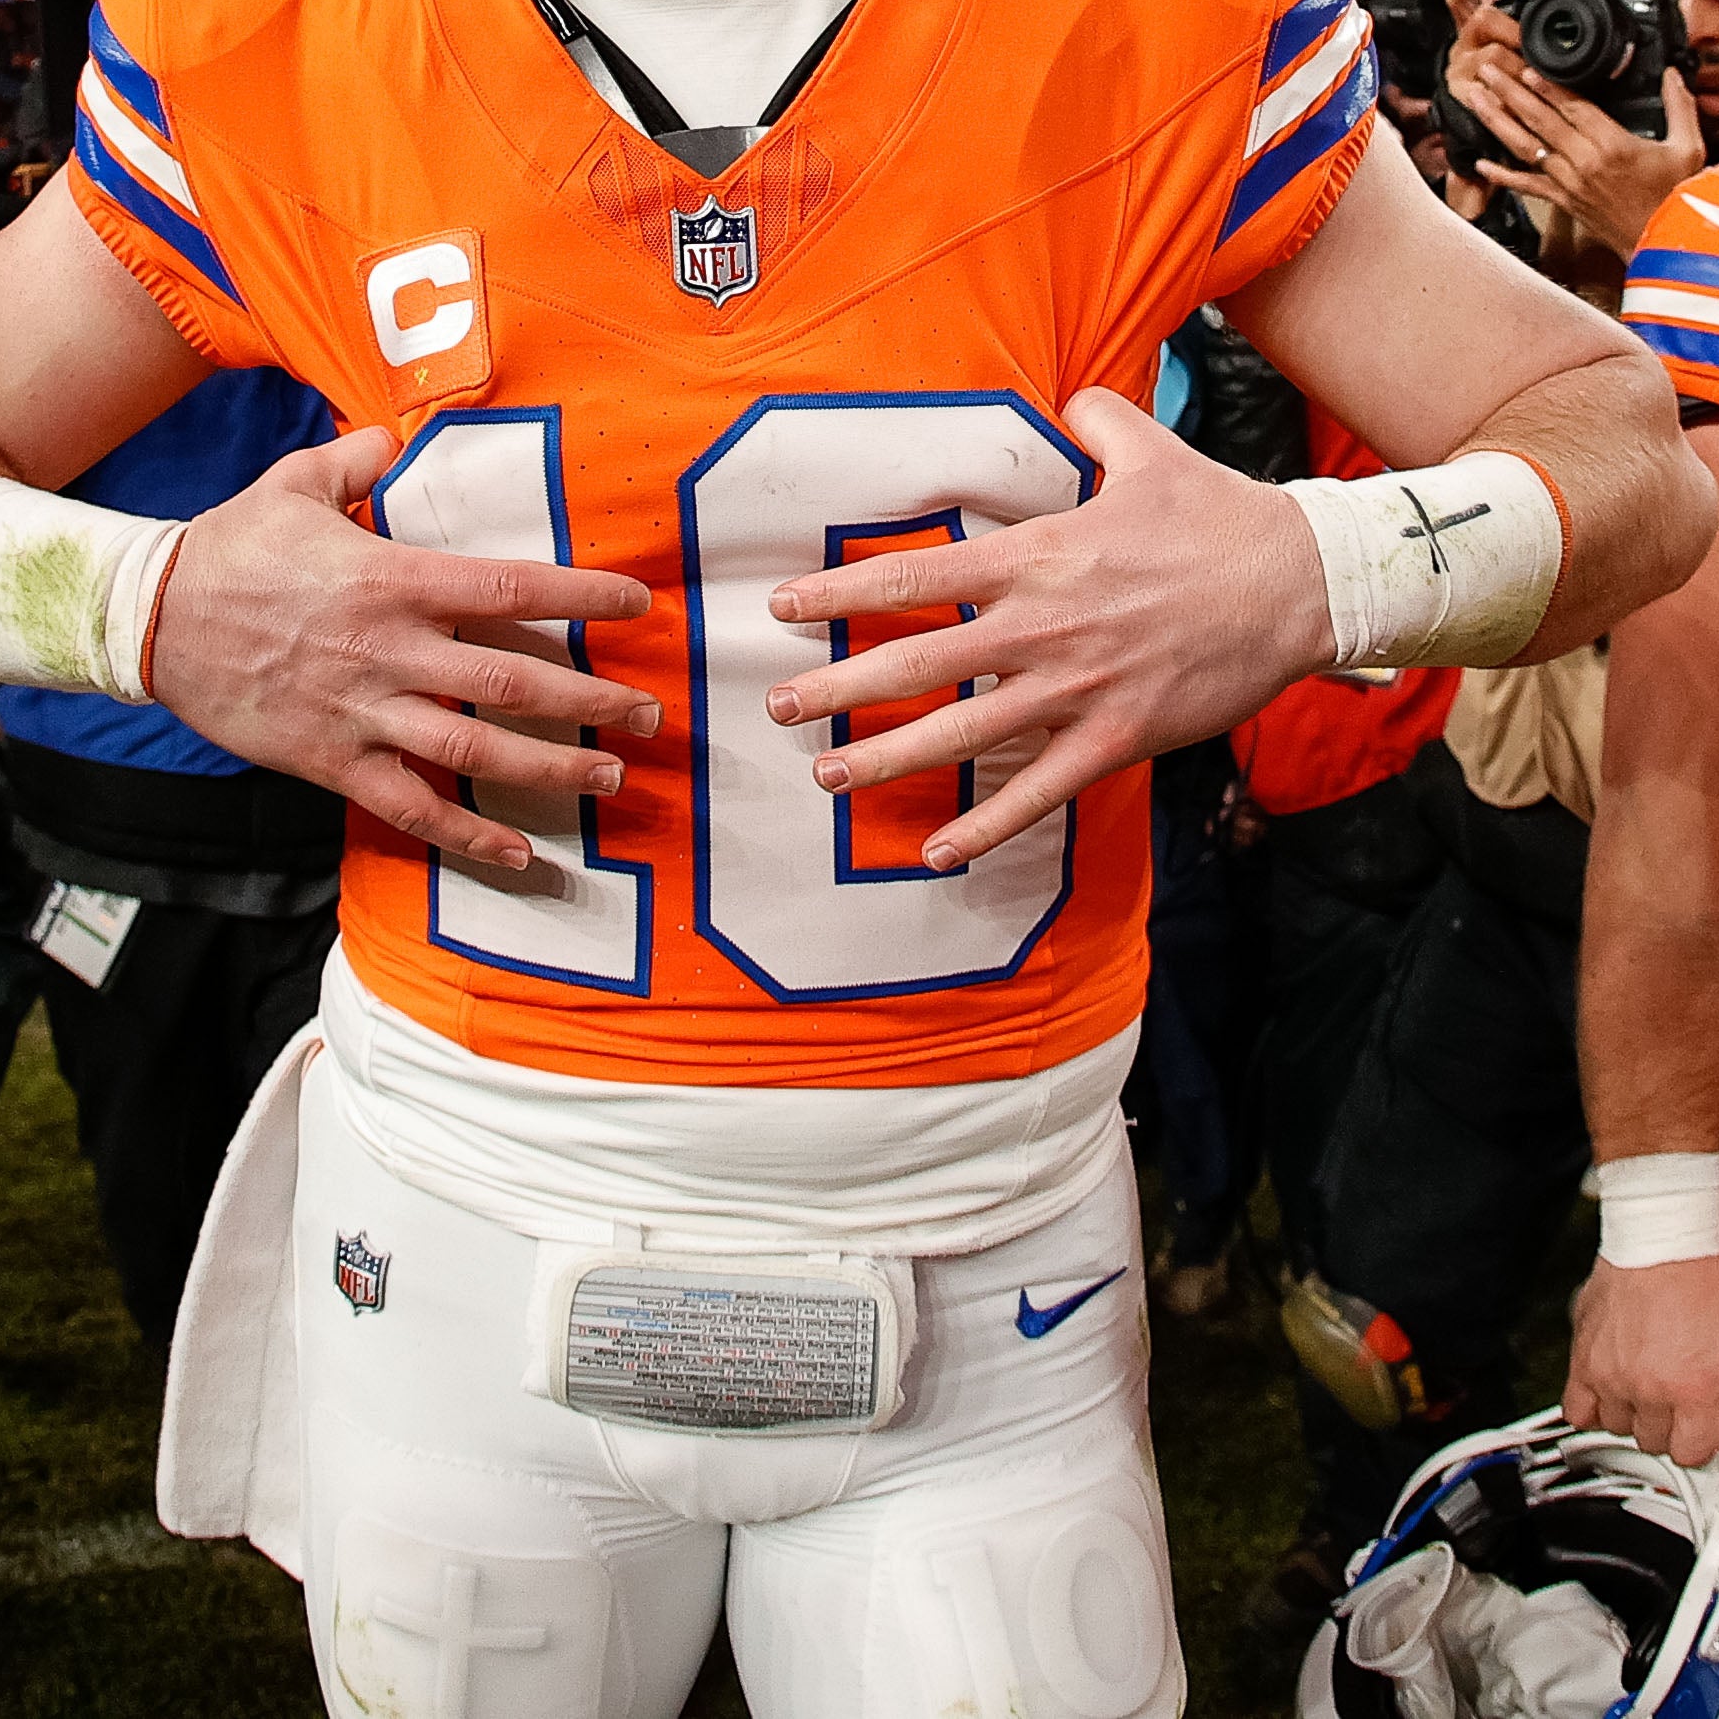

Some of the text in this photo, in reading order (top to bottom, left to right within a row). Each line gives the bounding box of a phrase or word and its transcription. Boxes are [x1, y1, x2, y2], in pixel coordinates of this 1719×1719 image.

[365, 242, 476, 369] C
[687, 245, 745, 288] NFL
[372, 389, 1097, 1004] 10
[339, 1264, 375, 1302] NFL
